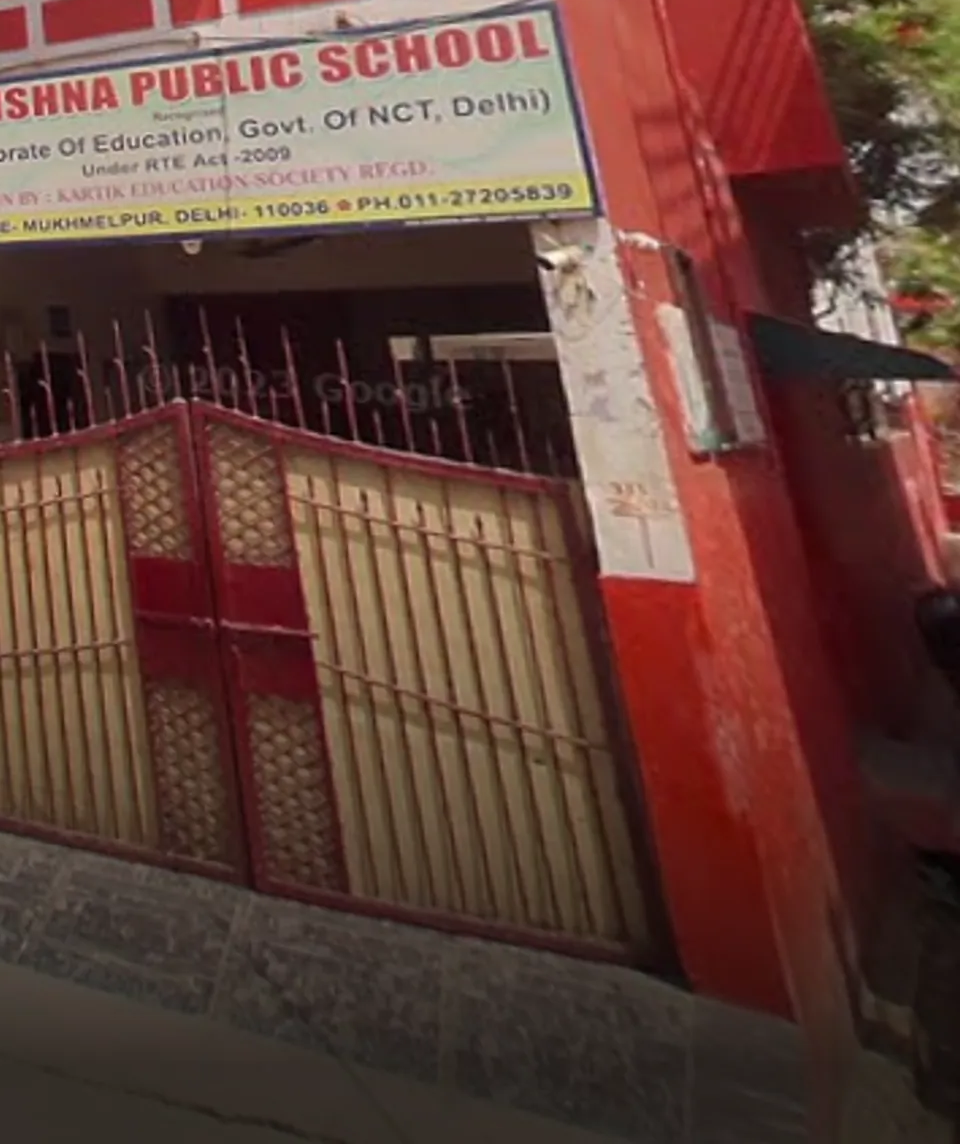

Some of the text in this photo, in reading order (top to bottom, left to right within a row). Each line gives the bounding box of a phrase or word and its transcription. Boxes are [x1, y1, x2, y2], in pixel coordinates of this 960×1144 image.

[129, 52, 304, 107] PUBLIC
[317, 19, 550, 83] SCHOOL
[58, 136, 85, 156] Of
[239, 118, 315, 139] Govt.
[324, 109, 358, 130] Of
[369, 98, 442, 125] NCT,
[453, 87, 551, 117] Delhi)
[19, 191, 41, 207] BY
[57, 185, 126, 204] KARTIK
[131, 173, 250, 198] EDUCATION
[256, 165, 349, 188] SOCIETY
[81, 160, 138, 178] Under
[145, 154, 185, 171] RTE
[254, 199, 330, 218] 110036
